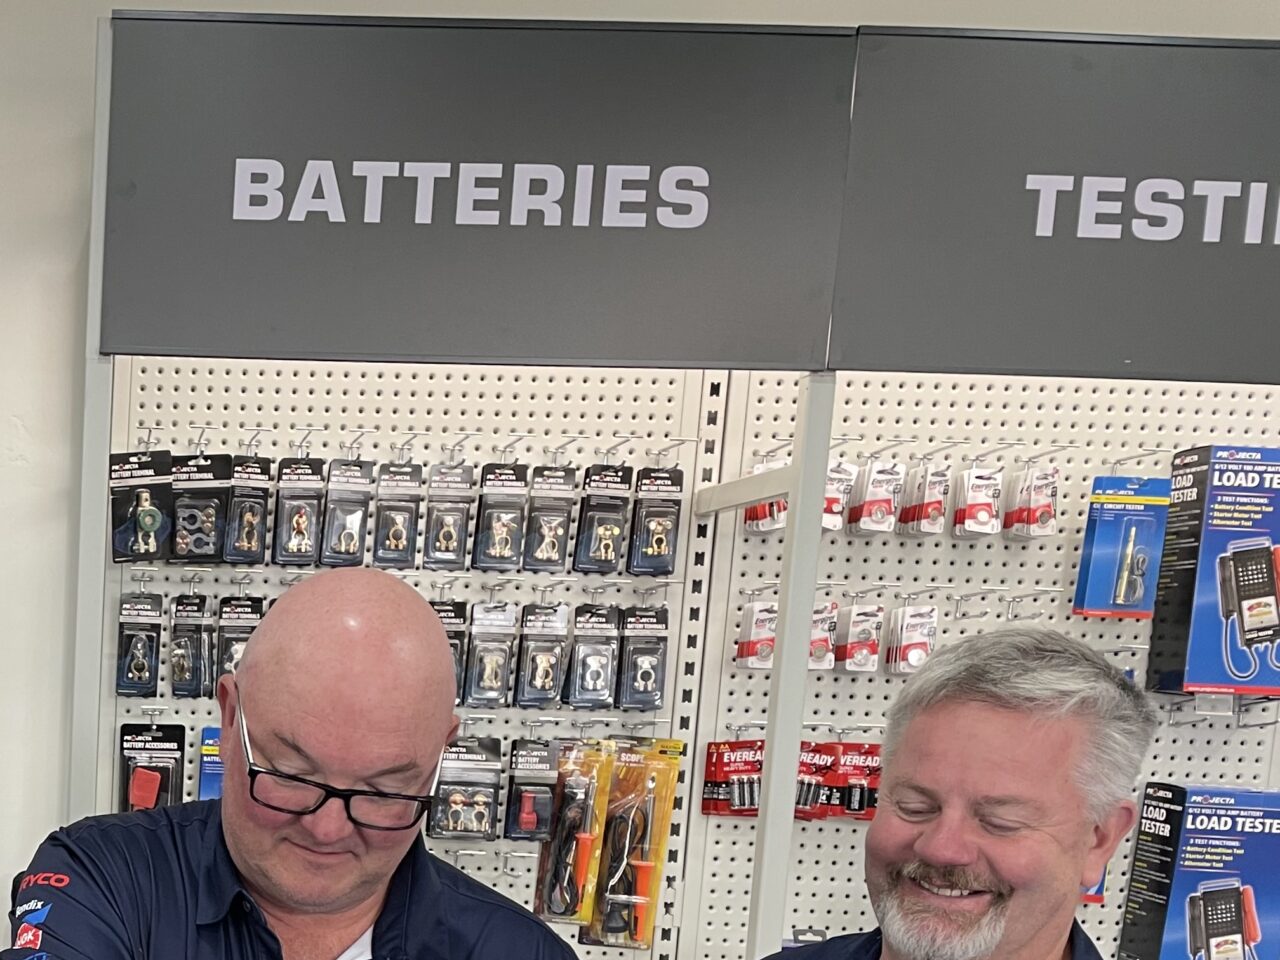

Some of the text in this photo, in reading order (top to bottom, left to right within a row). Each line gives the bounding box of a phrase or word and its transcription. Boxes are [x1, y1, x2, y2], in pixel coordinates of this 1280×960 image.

[233, 158, 709, 229] BATTERIES
[1025, 174, 1280, 245] TESTI
[1216, 450, 1261, 459] PROJECTA
[111, 469, 155, 479] BATTERY TERMINAL
[1171, 474, 1193, 488] LOAD
[1213, 471, 1260, 487] LOAD
[1171, 488, 1198, 503] TESTER
[621, 753, 644, 762] SCOPE
[724, 750, 765, 762] EVEREA
[1146, 788, 1172, 798] PROJECTA
[1191, 795, 1235, 804] PROJECTA
[1143, 805, 1167, 821] LOAD
[1141, 820, 1171, 837] TESTER
[1186, 814, 1233, 831] LOAD
[21, 873, 70, 889] RYCO
